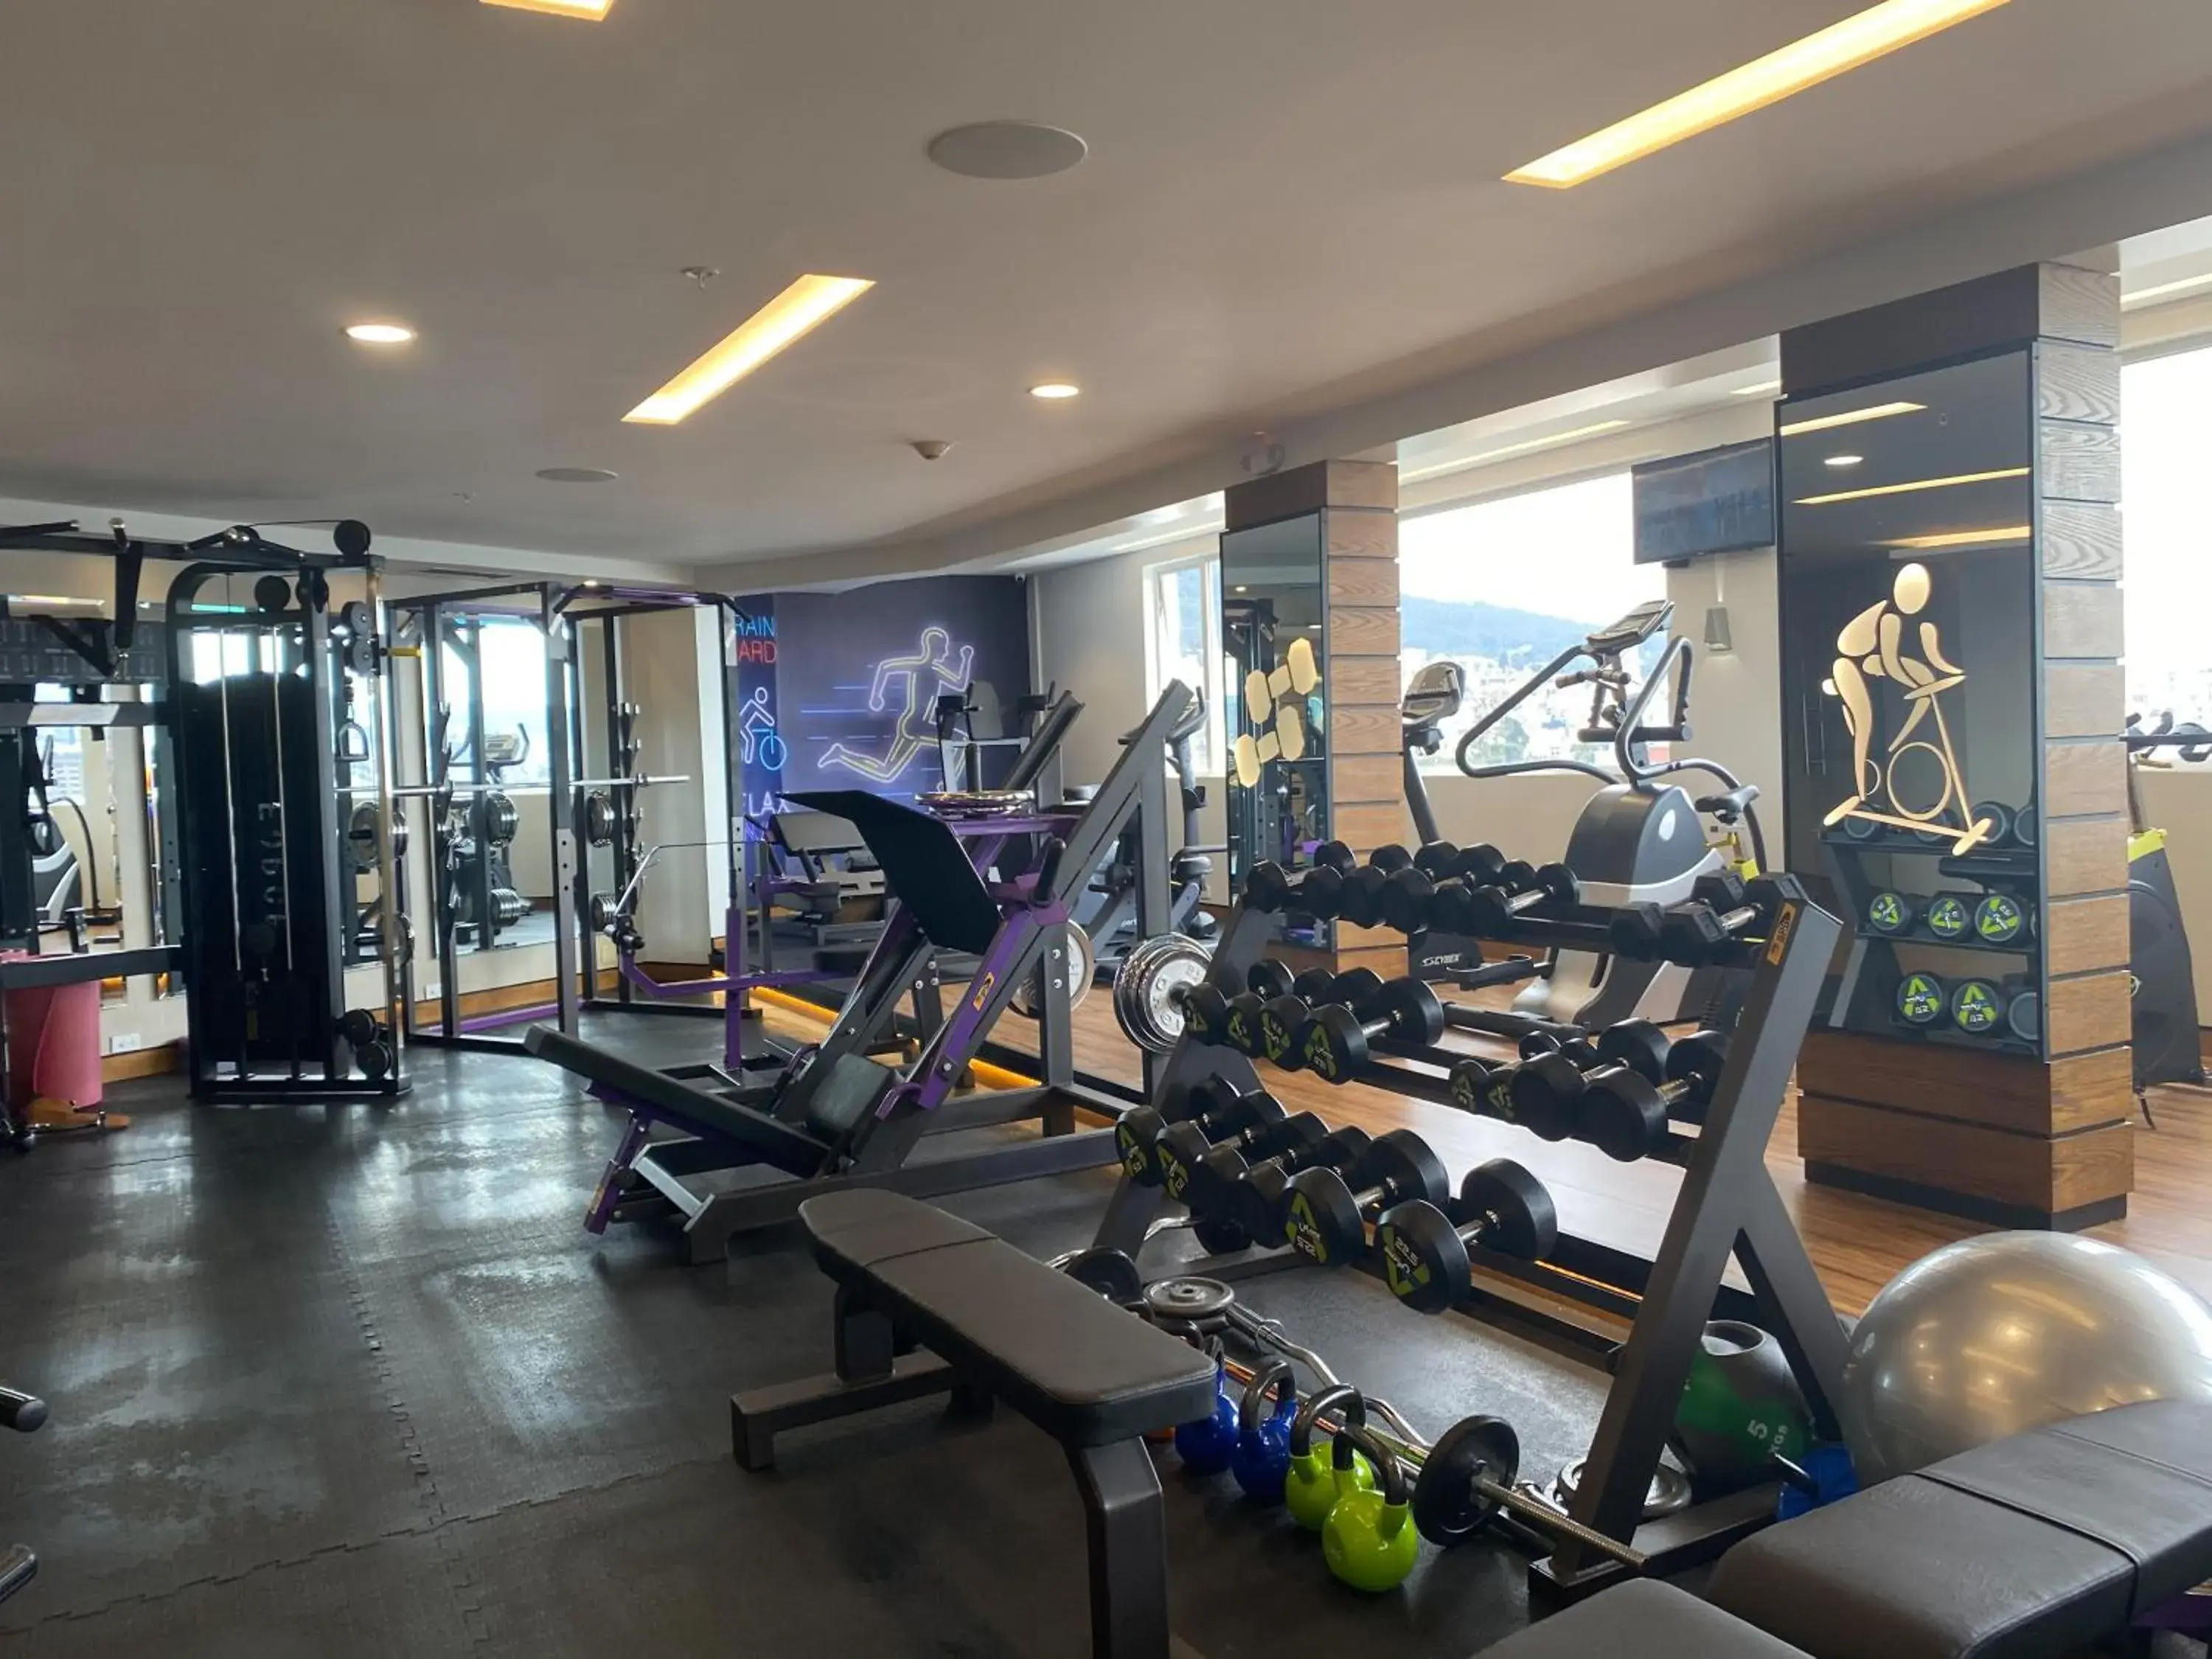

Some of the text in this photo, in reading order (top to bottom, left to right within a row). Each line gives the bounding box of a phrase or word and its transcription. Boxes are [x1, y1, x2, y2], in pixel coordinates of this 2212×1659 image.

[734, 614, 775, 638] RAIN
[738, 639, 777, 664] ARD
[742, 791, 790, 815] LAX
[1747, 1419, 1768, 1440] 5
